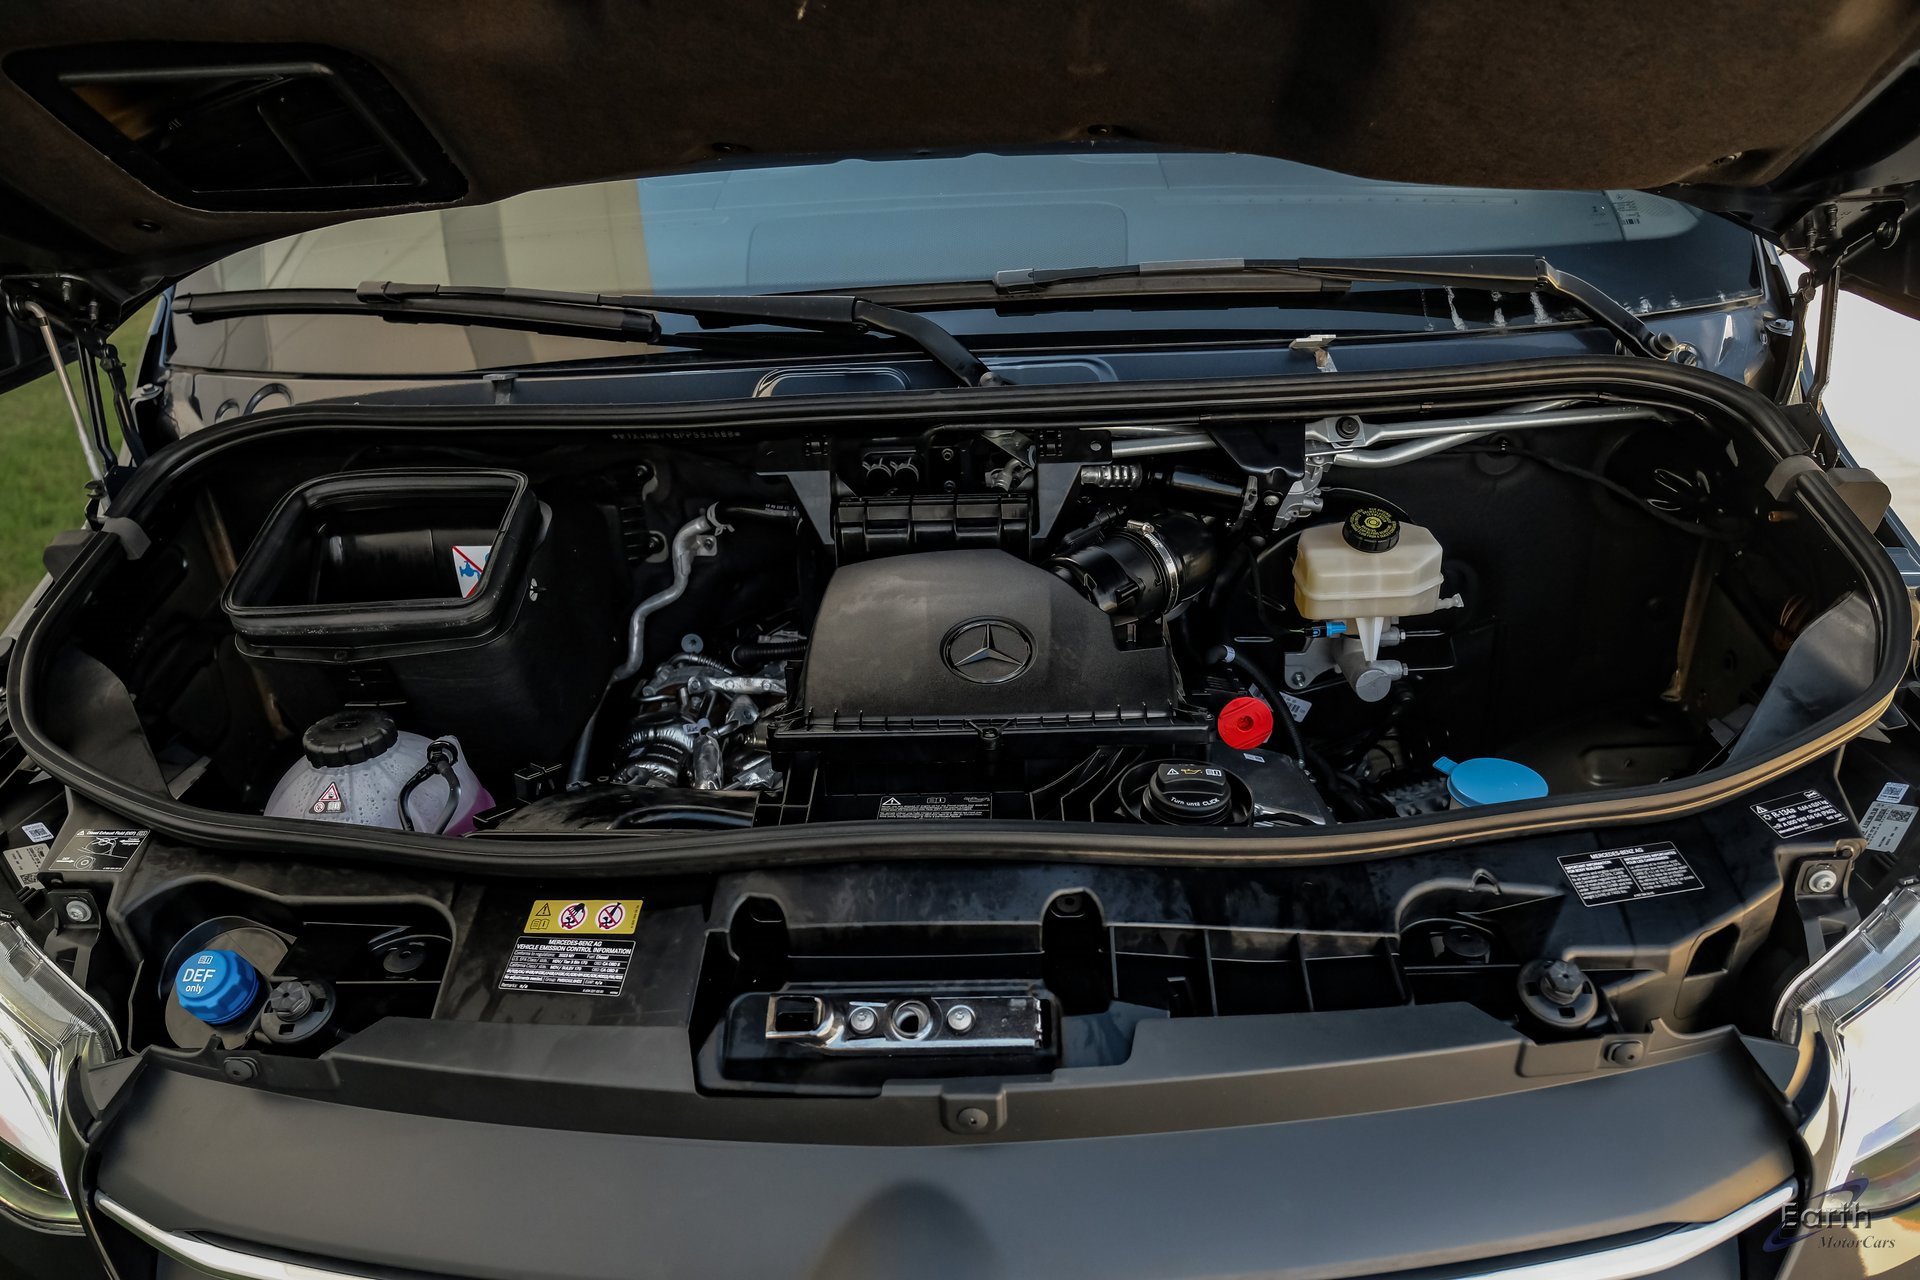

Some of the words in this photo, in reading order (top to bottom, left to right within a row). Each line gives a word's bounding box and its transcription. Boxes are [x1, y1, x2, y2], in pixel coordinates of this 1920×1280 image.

[1170, 796, 1185, 805] Turn
[1202, 797, 1220, 806] CLICK
[1770, 807, 1797, 818] R-134a
[1590, 849, 1636, 859] MERCEDES-BENZ
[182, 968, 216, 983] DEF
[185, 984, 204, 994] only
